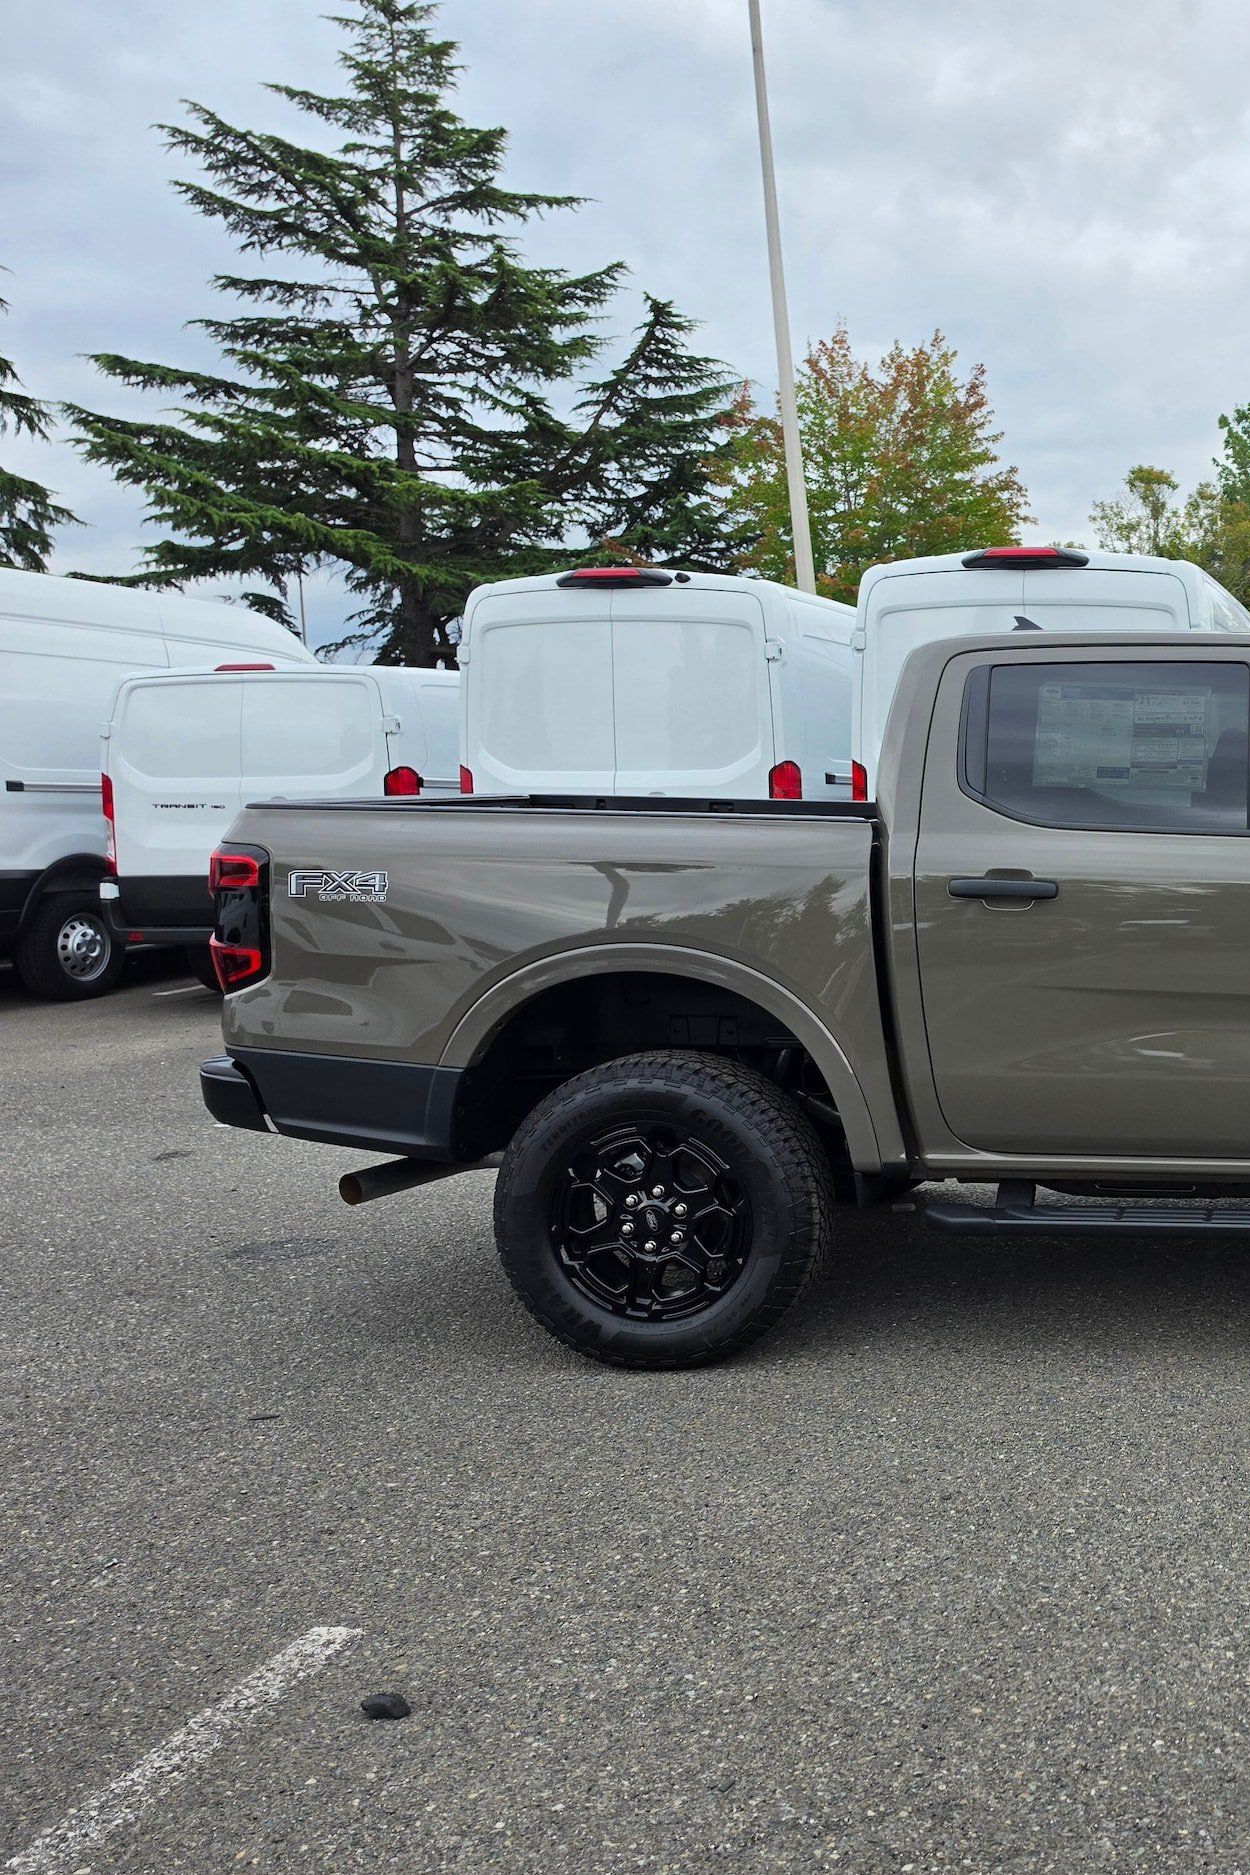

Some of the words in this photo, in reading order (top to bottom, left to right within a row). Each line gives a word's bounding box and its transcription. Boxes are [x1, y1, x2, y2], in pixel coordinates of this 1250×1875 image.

[288, 870, 388, 897] FX4
[319, 893, 346, 902] OFF
[349, 893, 387, 903] ROAD
